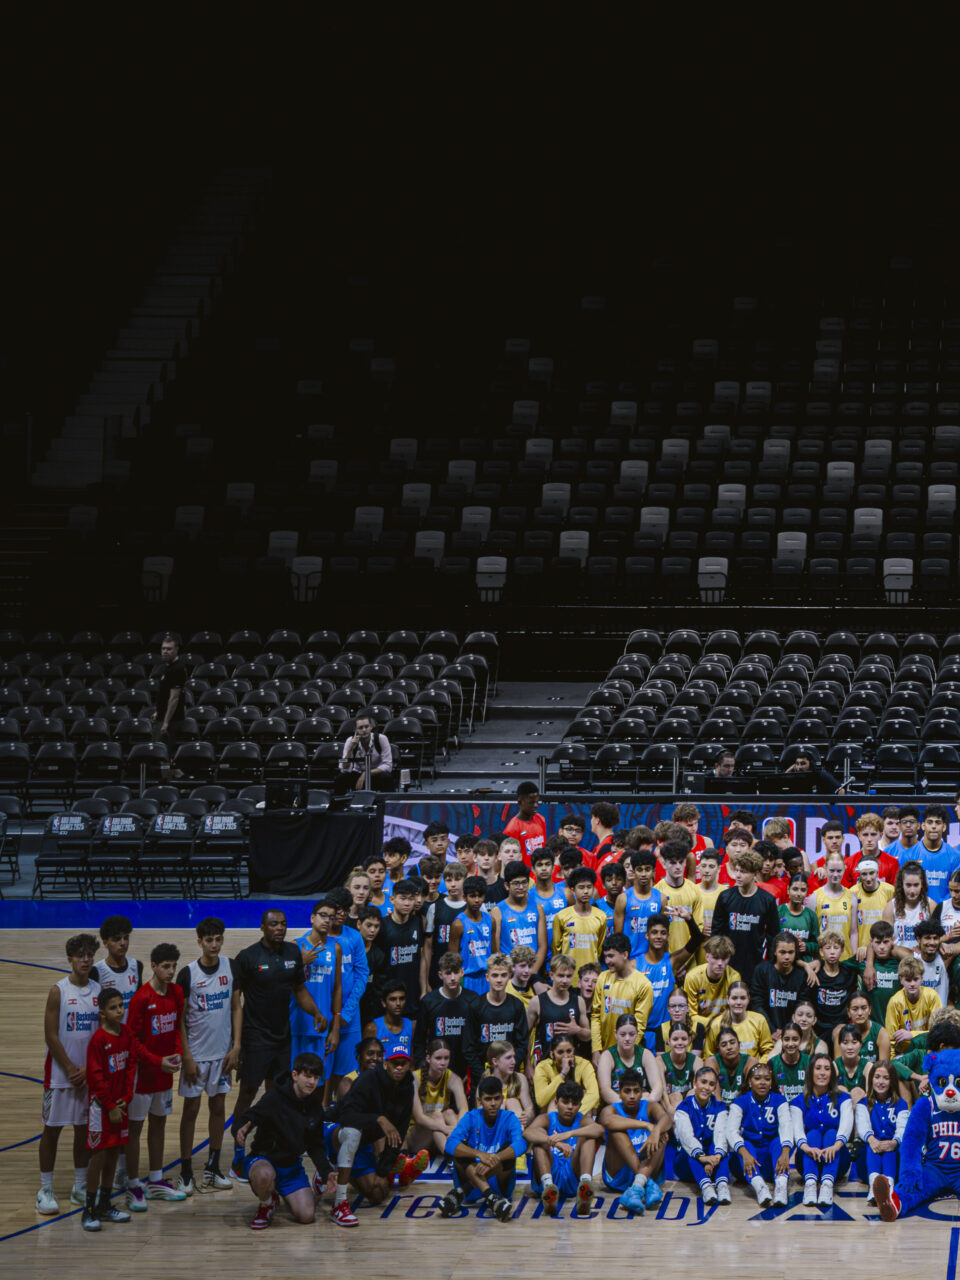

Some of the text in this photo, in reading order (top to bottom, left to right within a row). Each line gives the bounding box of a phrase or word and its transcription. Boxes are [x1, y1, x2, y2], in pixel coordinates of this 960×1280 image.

[553, 899, 564, 909] 95
[650, 903, 658, 912] 21
[326, 951, 332, 962] 2
[128, 975, 137, 985] 14
[219, 975, 228, 986] 10
[206, 989, 230, 1002] Basketball
[92, 997, 99, 1007] 6
[206, 1000, 224, 1011] School
[76, 1021, 92, 1031] School
[392, 1045, 409, 1054] PHILA
[867, 1040, 874, 1051] 6
[736, 1074, 742, 1086] 9
[797, 1069, 806, 1080] 10
[764, 1106, 775, 1124] 76
[887, 1108, 897, 1123] 76
[705, 1114, 715, 1131] 76
[655, 1190, 721, 1226] by
